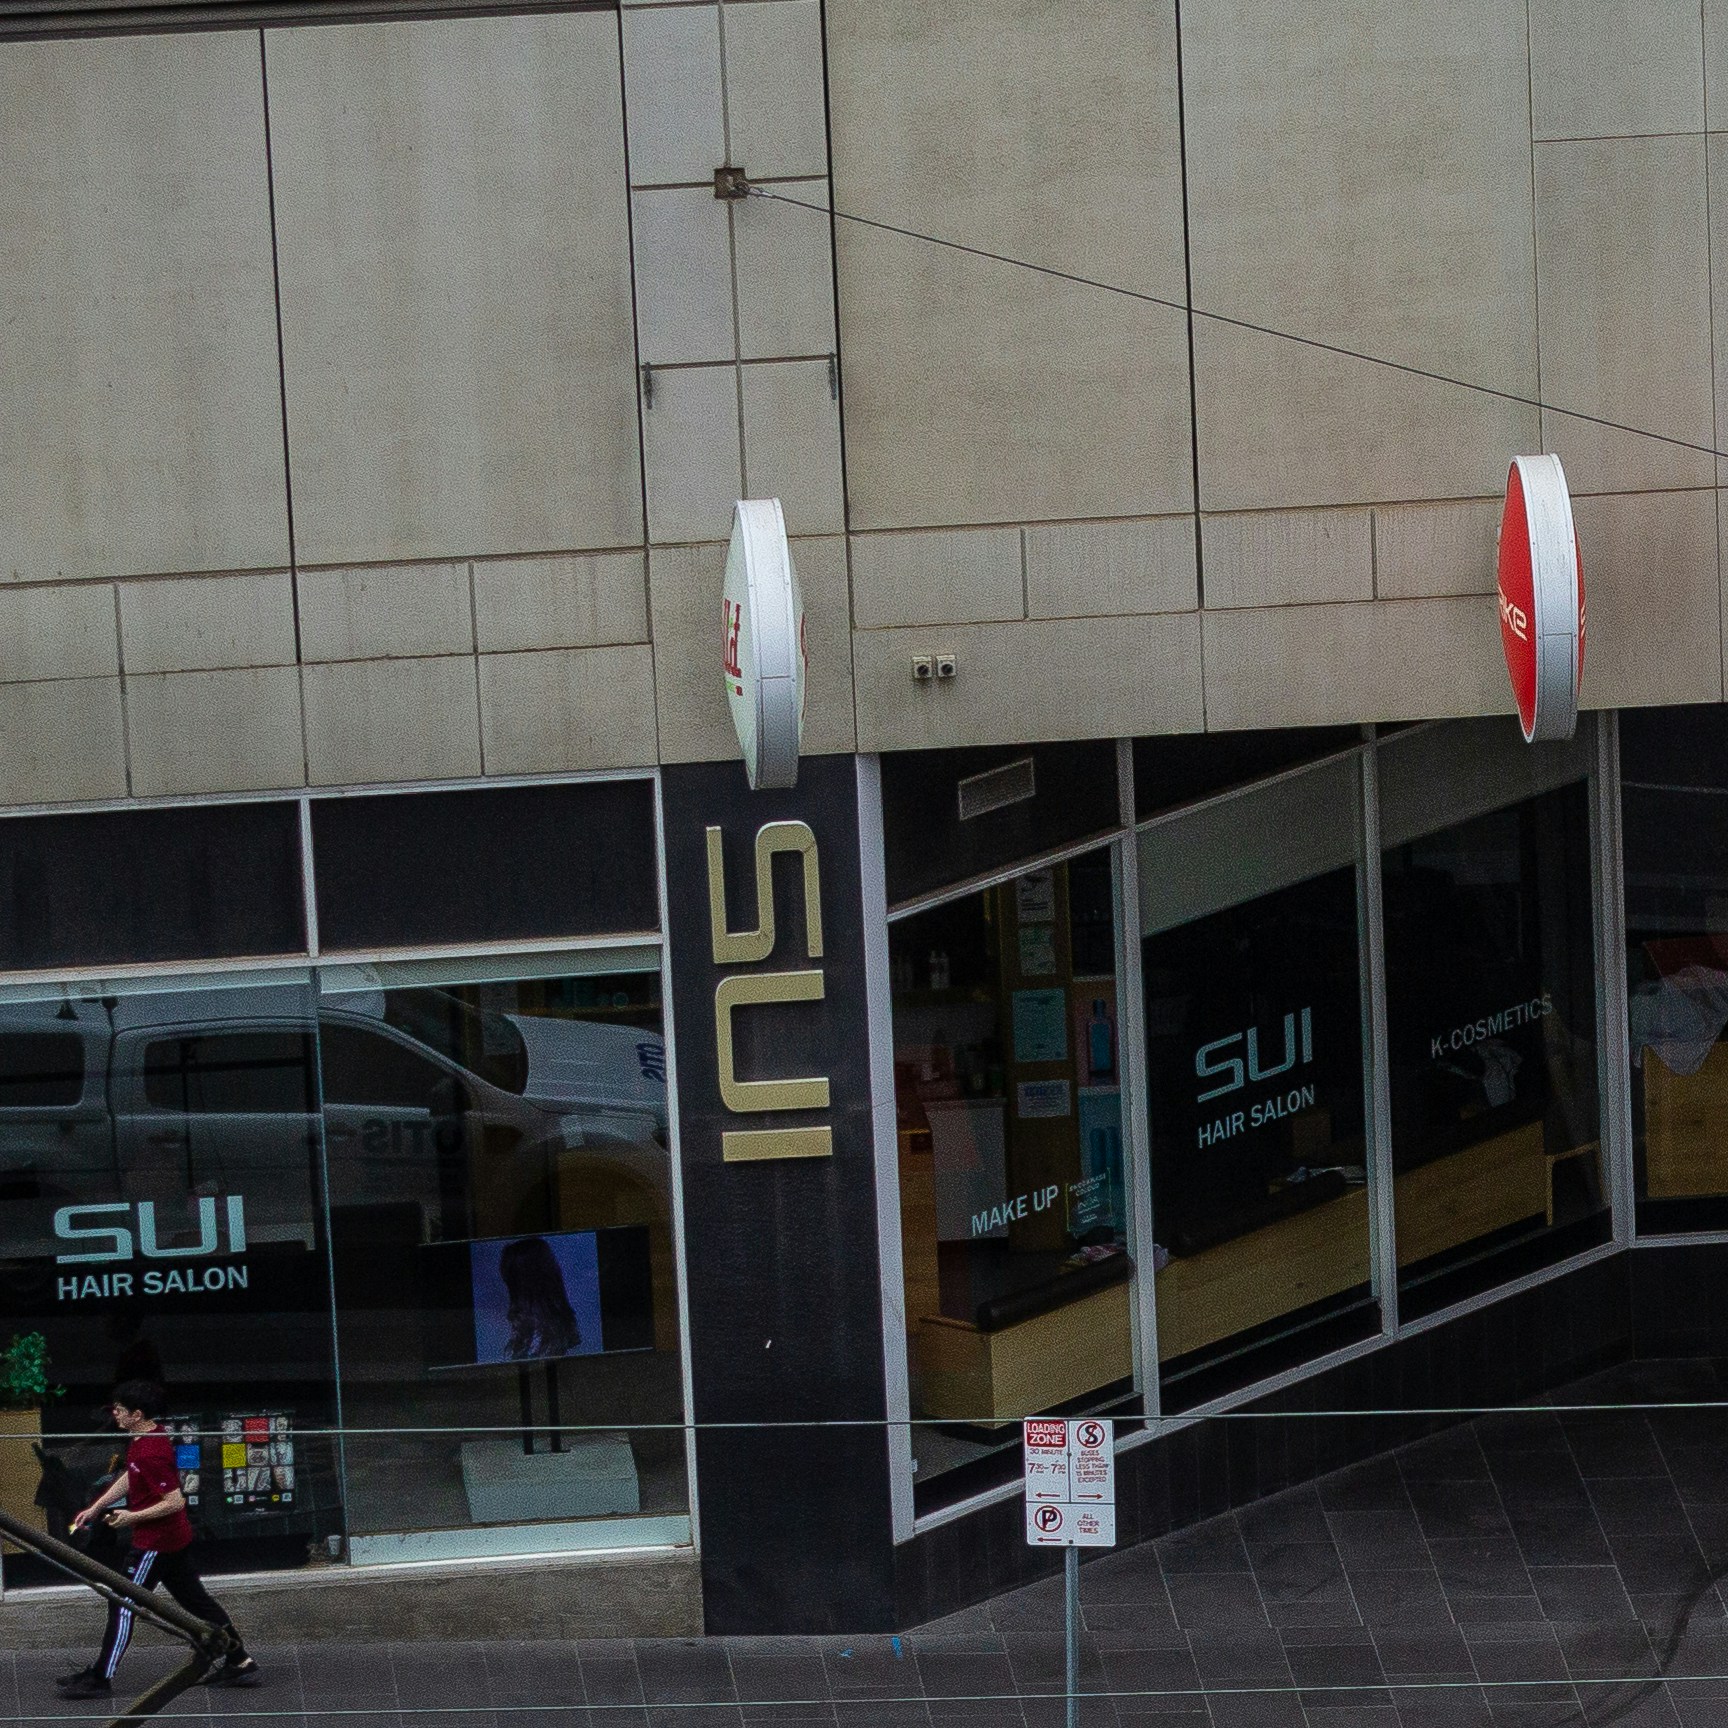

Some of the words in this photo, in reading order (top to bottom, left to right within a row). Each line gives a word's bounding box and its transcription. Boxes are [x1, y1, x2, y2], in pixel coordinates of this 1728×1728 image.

[706, 820, 833, 1162] SUI
[1195, 1007, 1315, 1103] SUI
[1430, 993, 1553, 1059] K-COSMETICS
[1197, 1109, 1245, 1149] HAIR
[1250, 1084, 1316, 1129] SALON
[53, 1194, 248, 1265] SUI
[971, 1192, 1028, 1237] MAKE
[1031, 1184, 1060, 1216] UP
[57, 1272, 134, 1301] HAIR
[143, 1265, 249, 1296] SALON
[1027, 1423, 1065, 1434] LOADING
[1029, 1434, 1064, 1445] ZONE
